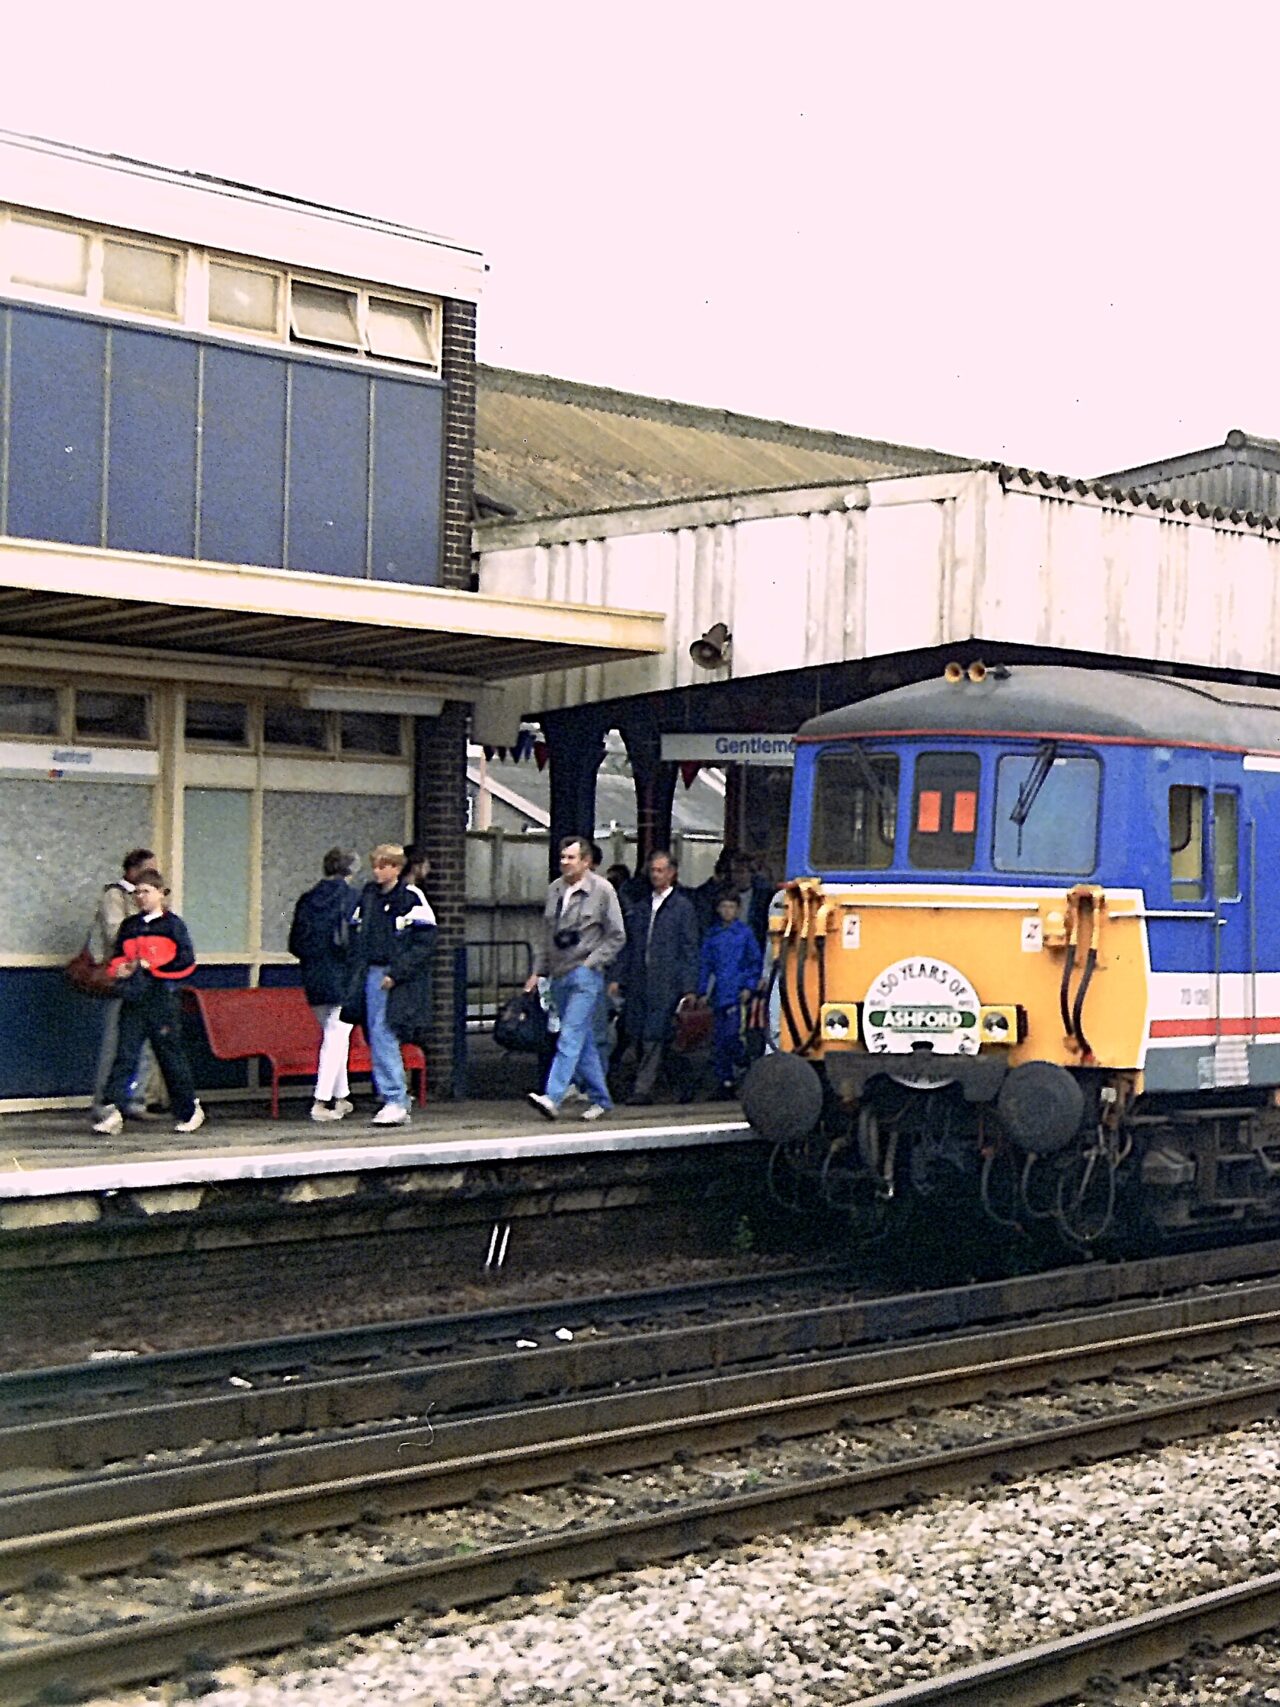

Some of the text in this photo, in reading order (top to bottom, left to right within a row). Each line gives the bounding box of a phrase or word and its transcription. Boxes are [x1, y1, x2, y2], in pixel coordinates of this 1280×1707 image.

[877, 963, 968, 997] 150 YEARS OF
[883, 1011, 963, 1028] ASHFORD
